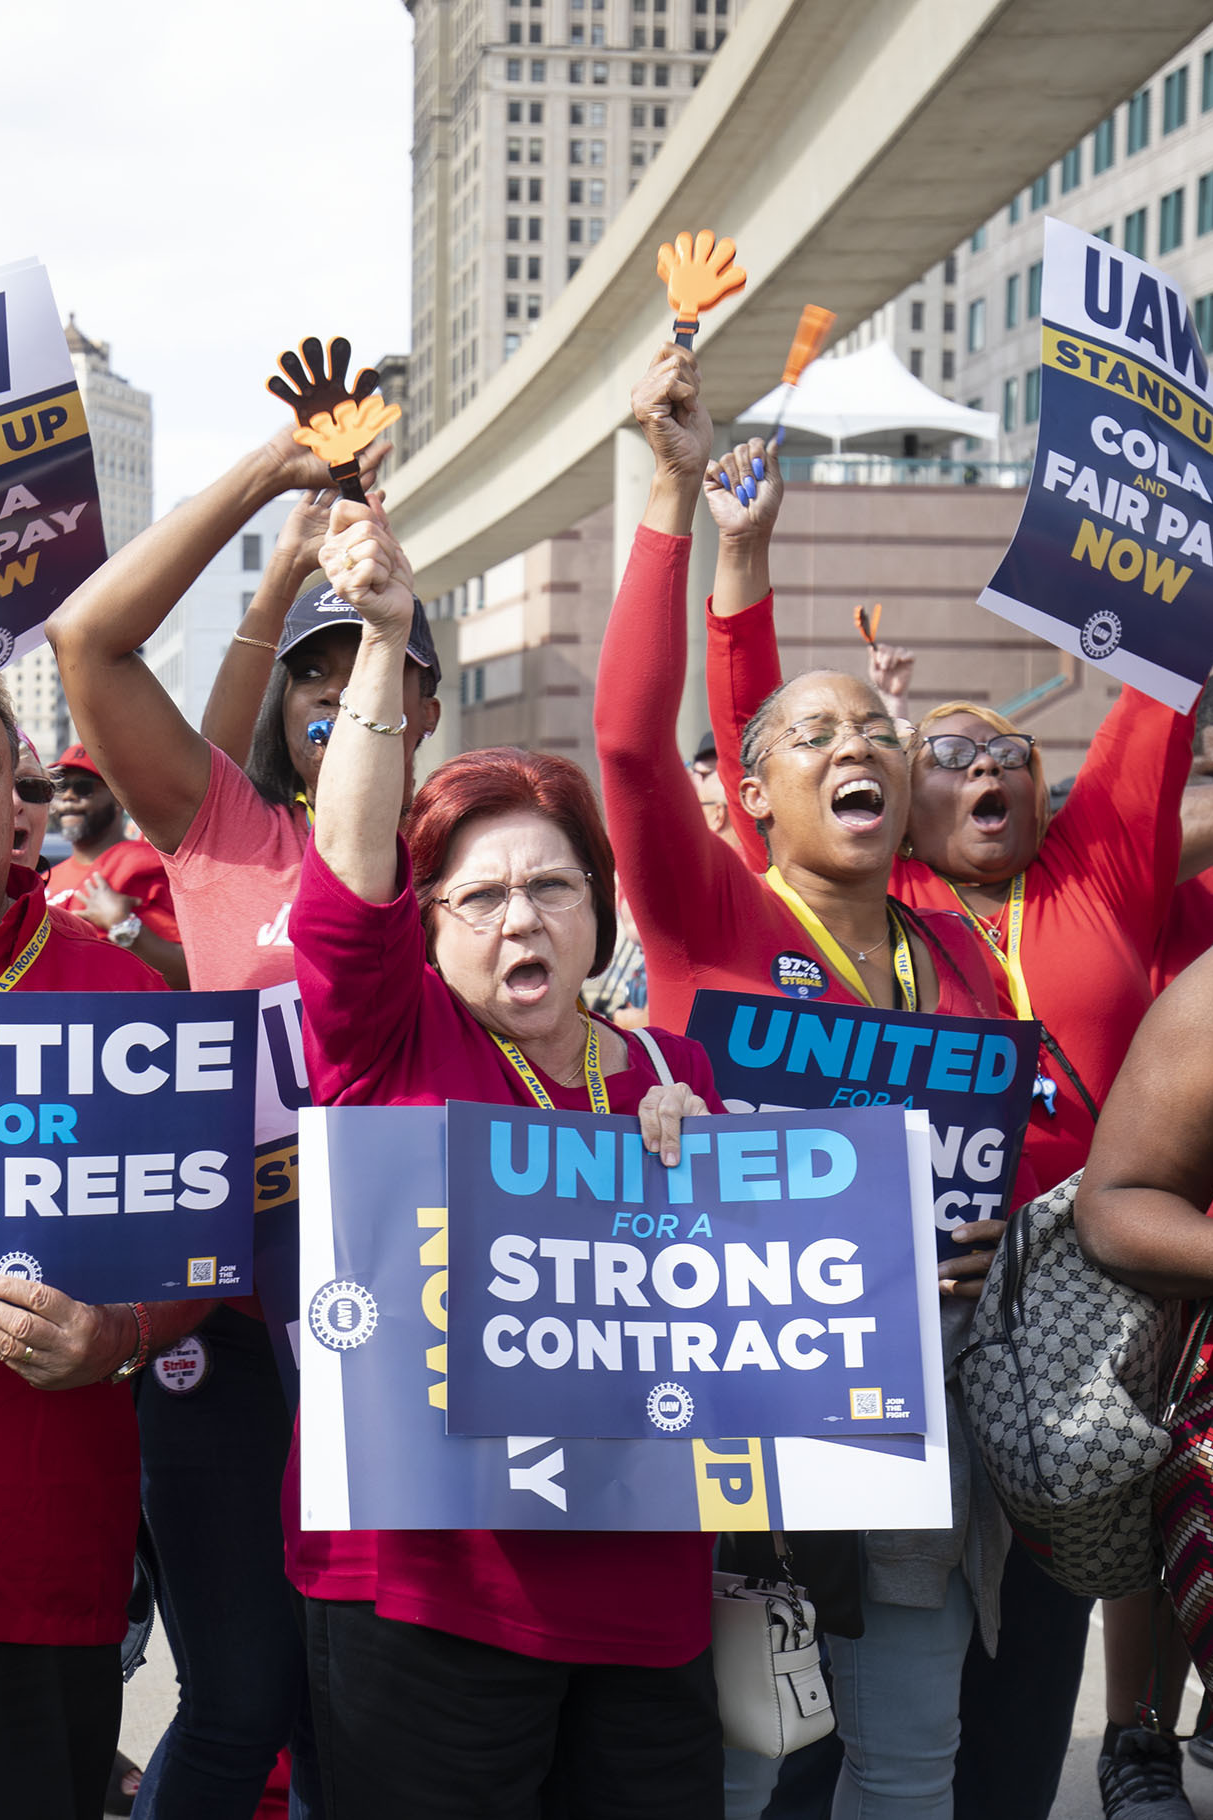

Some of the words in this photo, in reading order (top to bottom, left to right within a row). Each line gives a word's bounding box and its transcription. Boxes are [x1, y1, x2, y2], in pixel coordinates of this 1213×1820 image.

[1084, 245, 1209, 392] UAW
[1056, 340, 1182, 421] STAND
[2, 406, 68, 451] UP
[1091, 415, 1213, 504] COLA
[1133, 474, 1167, 498] AND
[1042, 449, 1149, 535] FAIR
[1156, 503, 1213, 567] PA
[1070, 518, 1194, 604] NOW
[5, 942, 39, 982] STRONG
[778, 956, 820, 974] 97%
[779, 970, 808, 978] READY
[780, 976, 823, 987] STRIKE
[898, 953, 909, 975] THE
[507, 1046, 530, 1072] THE
[727, 1005, 1018, 1095] UNITED
[588, 1071, 607, 1114] STRONG
[829, 1087, 891, 1108] FOR
[490, 1120, 858, 1205] UNITED
[612, 1212, 679, 1239] FOR
[687, 1213, 713, 1239] A
[486, 1233, 864, 1309] STRONG
[337, 1301, 353, 1329] UAW
[482, 1313, 877, 1373] CONTRACT
[659, 1401, 680, 1412] UAW
[886, 1411, 911, 1419] FIGHT
